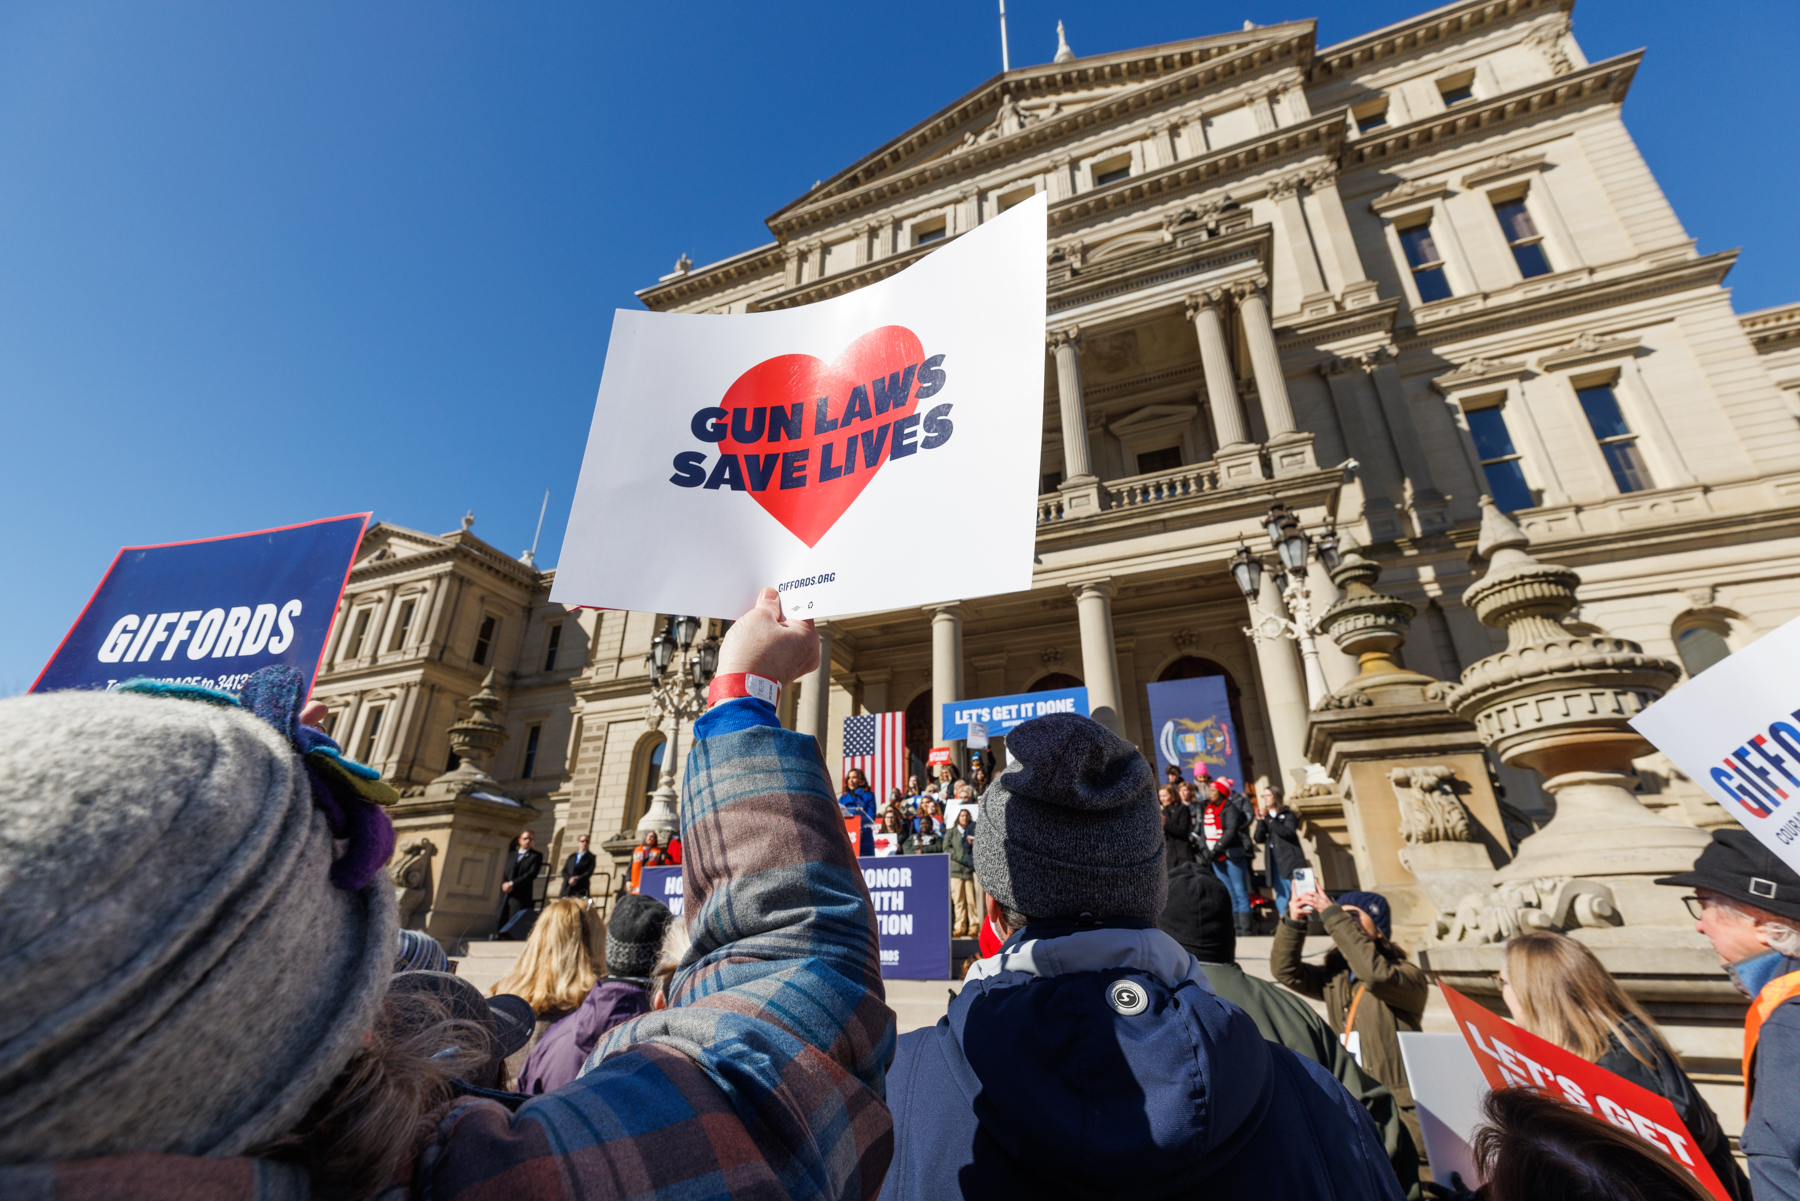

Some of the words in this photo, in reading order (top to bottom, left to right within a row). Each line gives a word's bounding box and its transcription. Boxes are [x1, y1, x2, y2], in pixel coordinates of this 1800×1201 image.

[690, 401, 804, 444] GUN
[813, 354, 947, 435] LAWS
[669, 448, 809, 491] SAVE
[818, 403, 954, 483] LIVES
[778, 572, 836, 593] GIFFORDS.ORG
[97, 599, 303, 664] GIFFORDS
[954, 707, 991, 725] LET'S
[992, 704, 1019, 721] GET
[1020, 702, 1035, 718] IT
[1036, 697, 1076, 717] DONE
[1465, 1020, 1594, 1115] LET'S
[1595, 1095, 1695, 1166] GET
